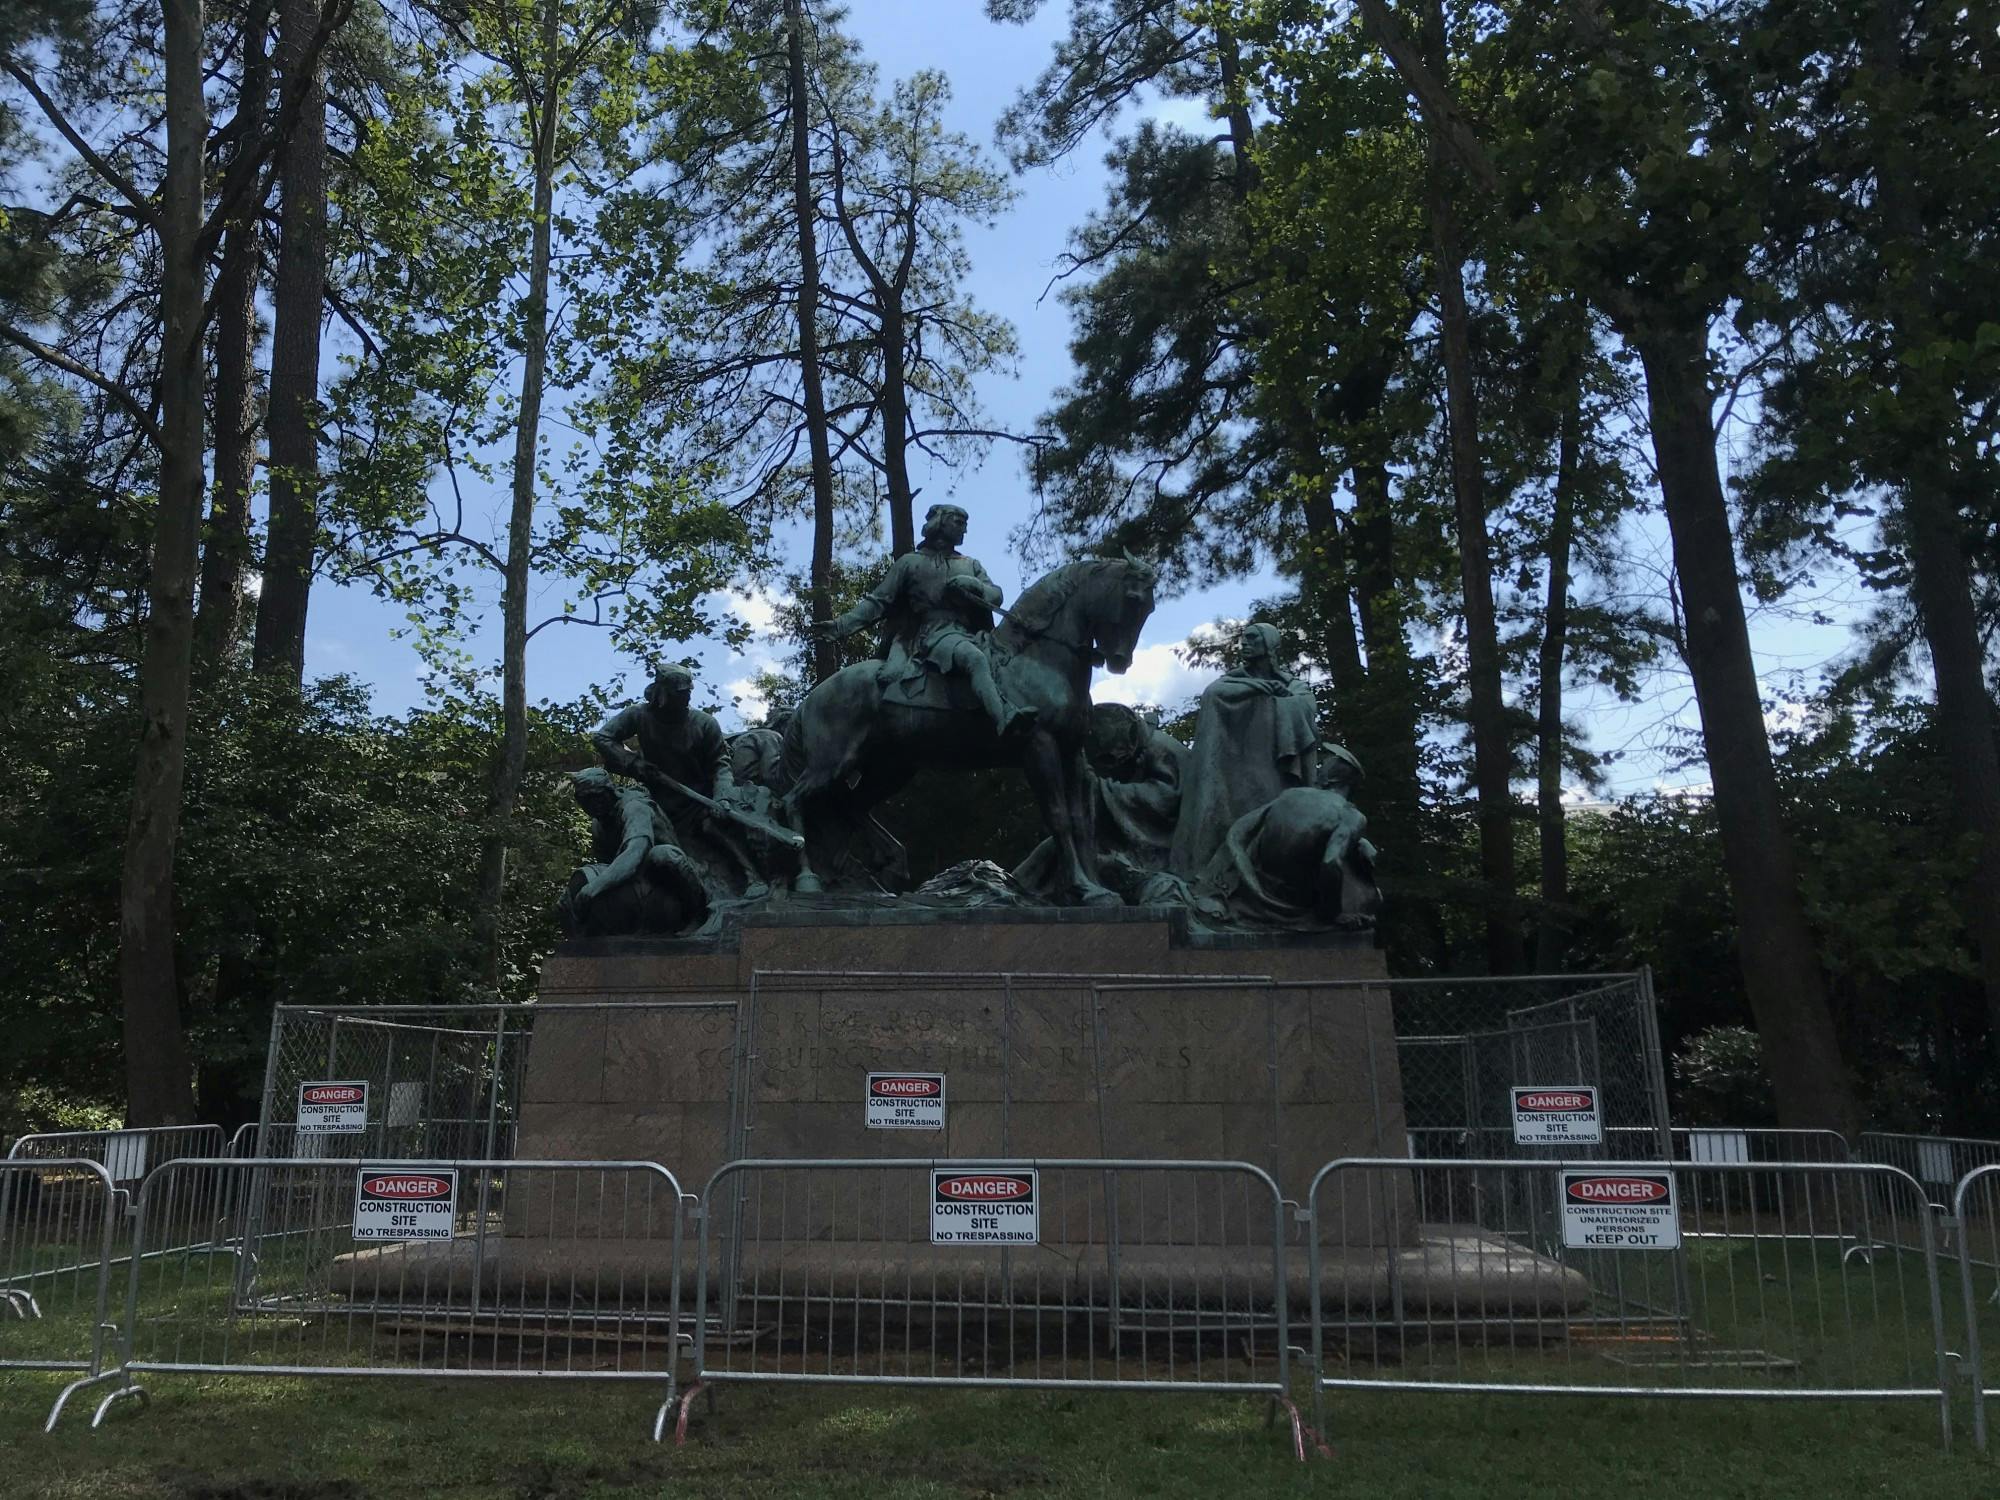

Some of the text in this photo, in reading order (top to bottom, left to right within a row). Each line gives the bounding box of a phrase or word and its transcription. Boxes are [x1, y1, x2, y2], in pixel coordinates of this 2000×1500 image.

[700, 1010, 864, 1032] GORGE
[881, 1083, 929, 1093] DANGER
[312, 1089, 355, 1100] DANGER
[869, 1099, 941, 1107] CONSTRUCTION
[1528, 1096, 1581, 1107] DANGER
[301, 1105, 364, 1113] CONSTRUCTION
[895, 1109, 915, 1117] SITE
[323, 1115, 341, 1123] SITE
[1517, 1113, 1595, 1122] CONSTRUCTION
[1547, 1124, 1568, 1132] SITE
[375, 1181, 438, 1193] DANGER
[952, 1182, 1017, 1195] DANGER
[1582, 1184, 1653, 1197] DANGER
[359, 1202, 451, 1214] CONSTRUCTION
[935, 1205, 1034, 1215] CONSTRUCTION
[392, 1215, 417, 1226] SITE
[971, 1218, 998, 1229] SITE
[1580, 1216, 1660, 1224] UNAUTHORIZED
[358, 1228, 449, 1237] NO TRESPASSING
[936, 1232, 1034, 1241] NO TRESPASSING
[1585, 1234, 1659, 1244] KEEP OUT
